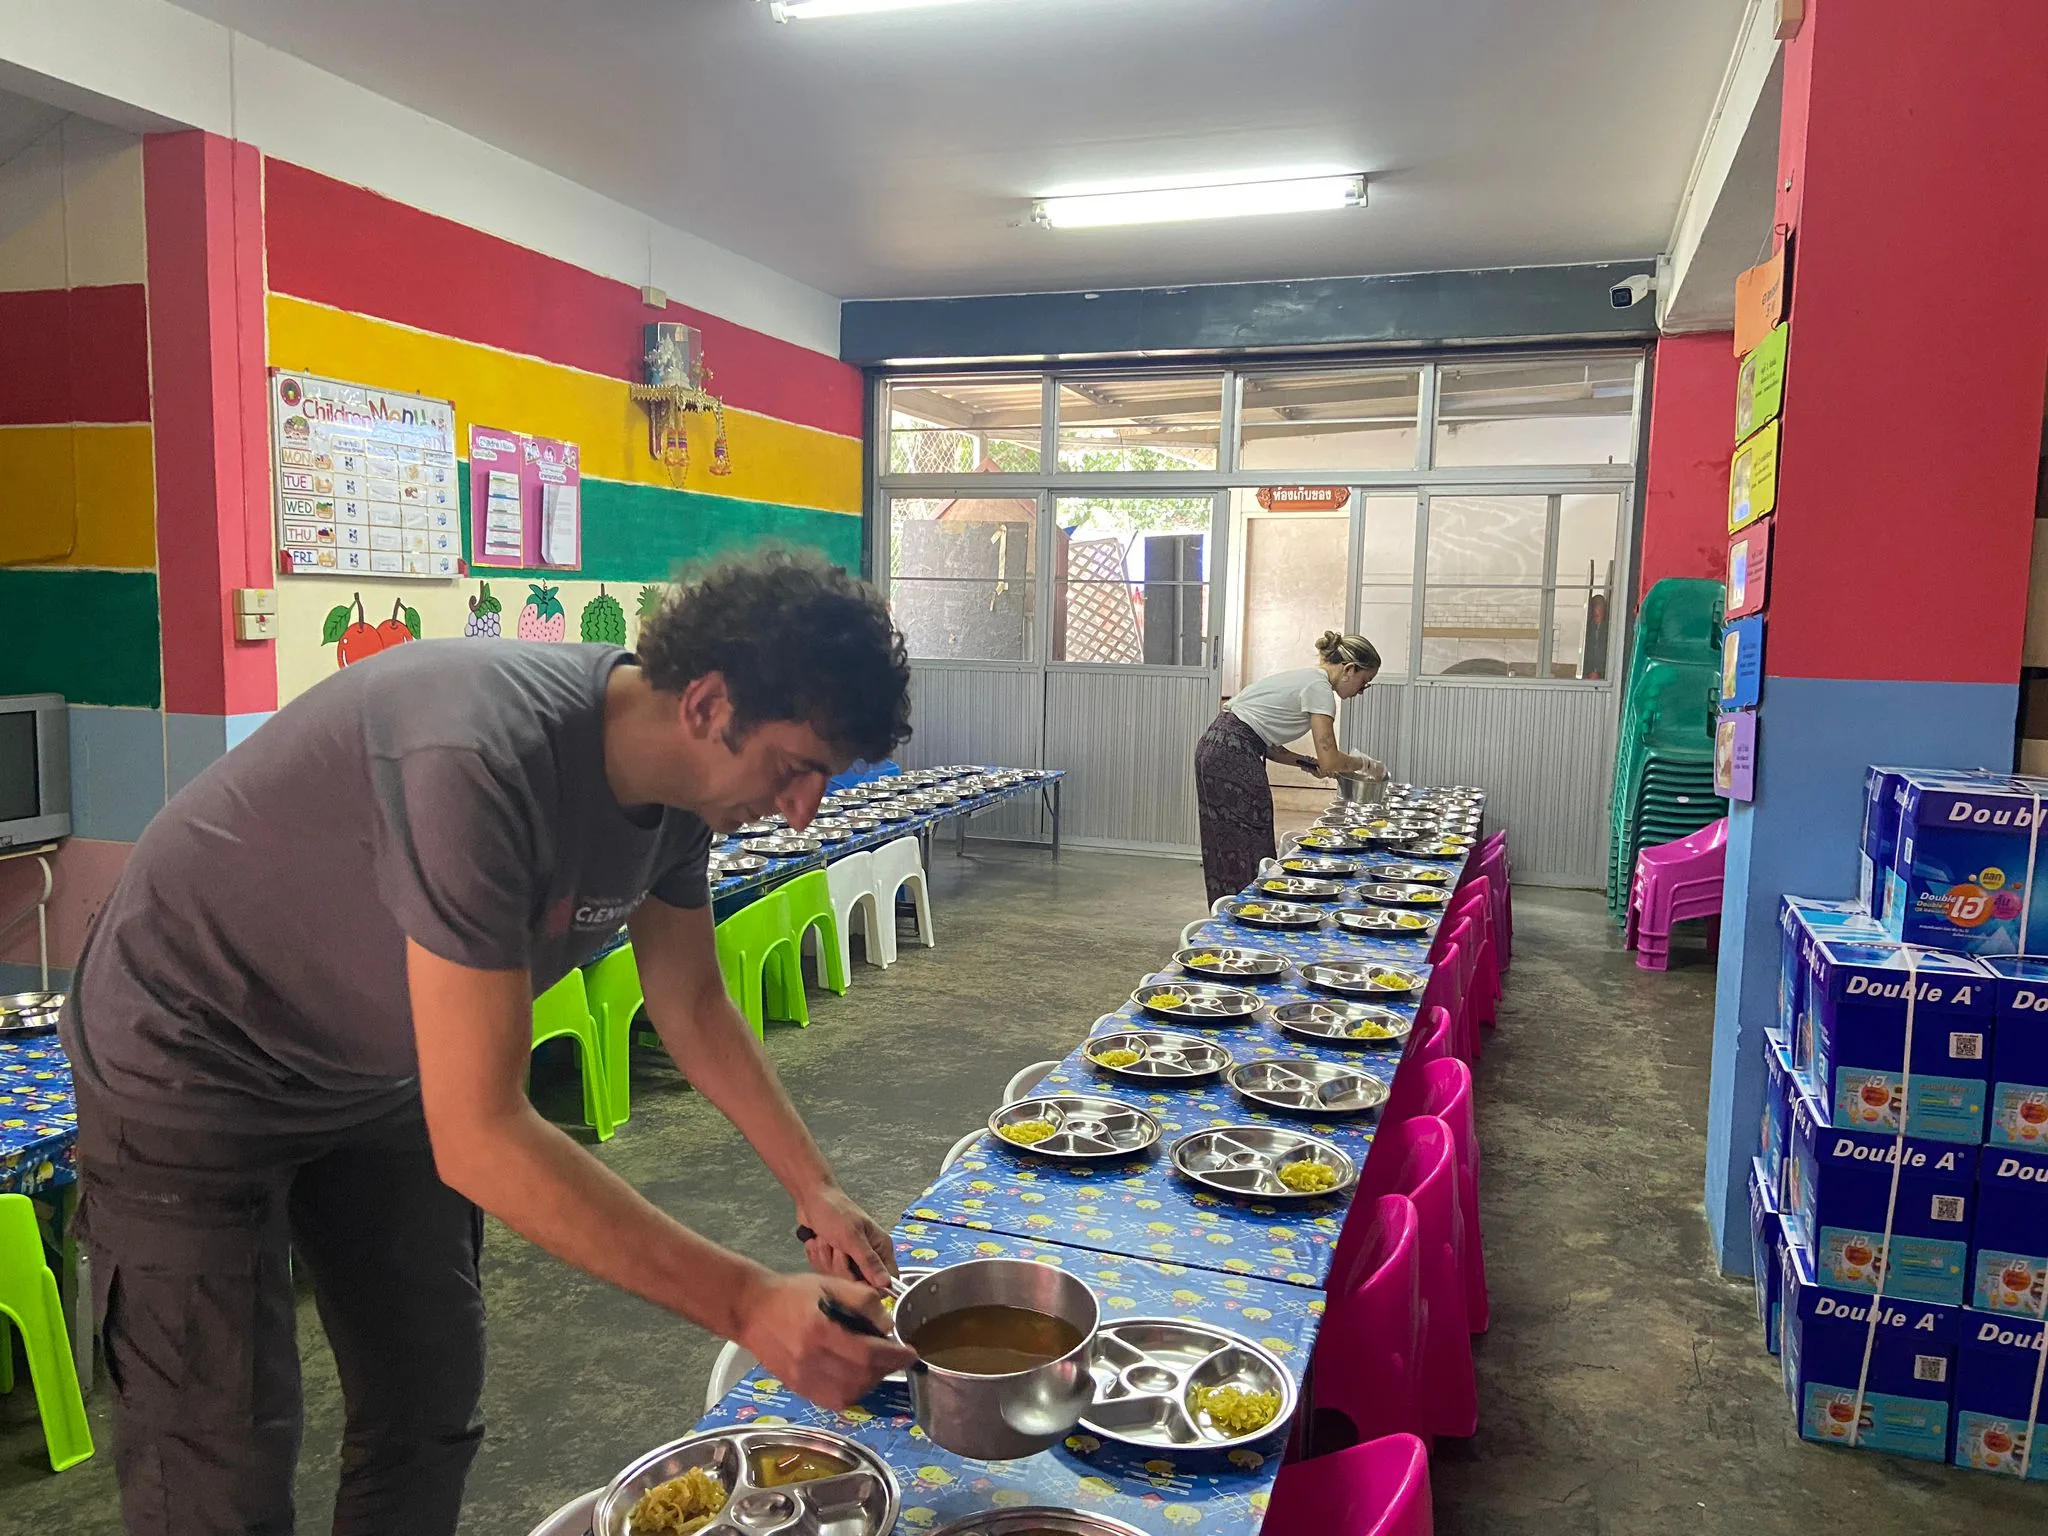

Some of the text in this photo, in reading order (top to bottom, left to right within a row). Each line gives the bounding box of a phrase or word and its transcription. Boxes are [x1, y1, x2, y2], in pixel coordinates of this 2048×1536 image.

[284, 450, 311, 466] MON
[284, 474, 307, 488] TUE
[1273, 487, 1331, 501] ห้องเก็บของ
[286, 501, 312, 514] WED
[288, 528, 312, 541] THU
[293, 551, 313, 563] FRI
[1920, 891, 1957, 904] Double
[1846, 975, 1943, 1002] Double
[2012, 990, 2048, 1012] Do
[1833, 1138, 1927, 1168] Double
[1997, 1158, 2048, 1183] Dou
[1814, 1297, 1907, 1327] Double
